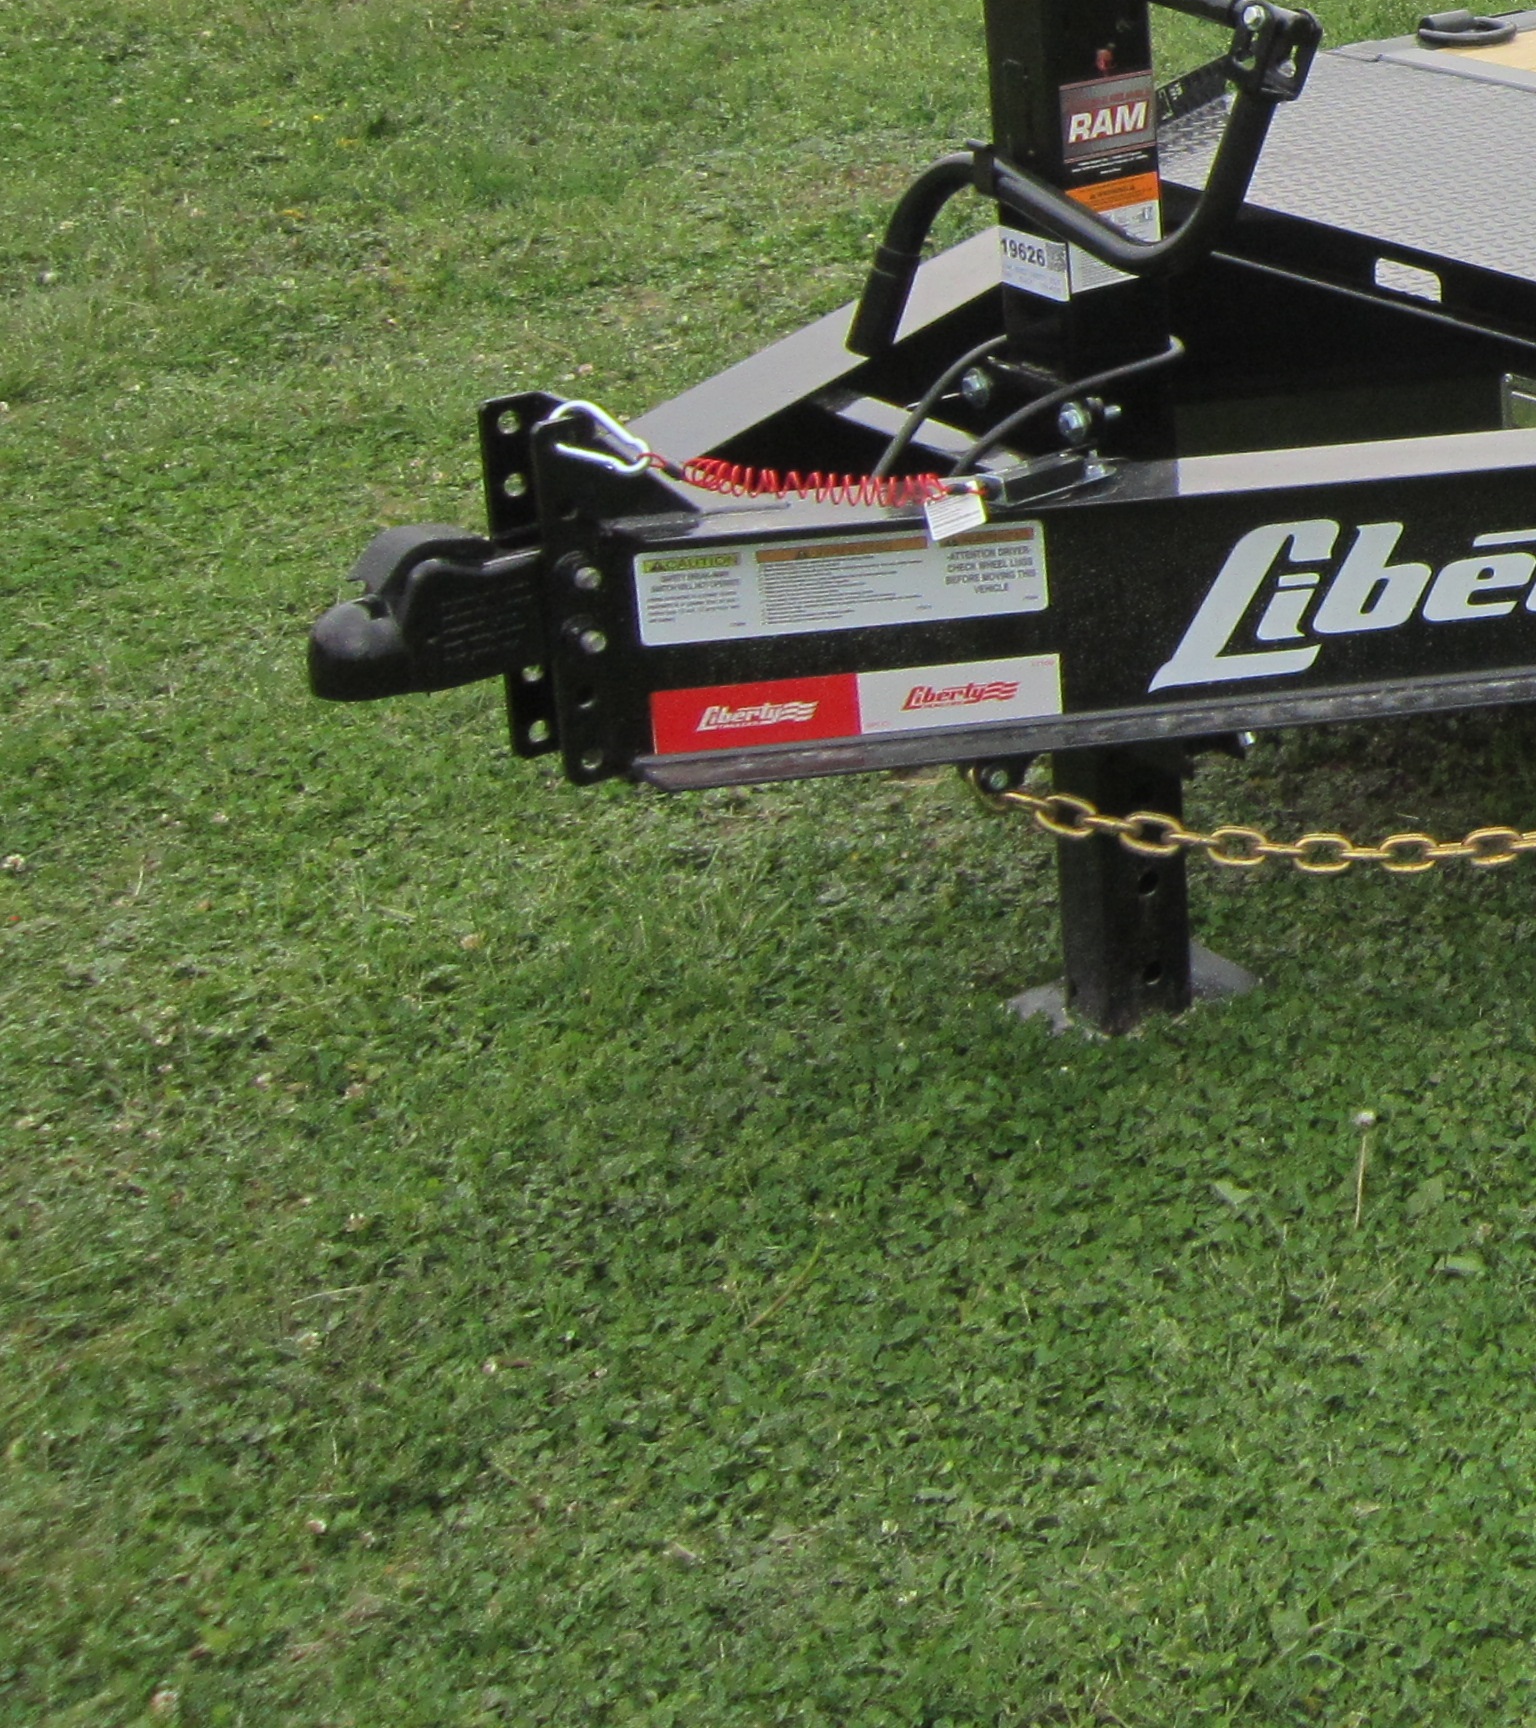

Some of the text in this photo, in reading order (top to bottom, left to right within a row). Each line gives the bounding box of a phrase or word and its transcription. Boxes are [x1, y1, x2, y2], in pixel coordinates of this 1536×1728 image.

[1068, 101, 1148, 144] RAM
[1000, 237, 1046, 268] 19626
[901, 681, 988, 712] Liberty
[695, 701, 785, 733] Liberty
